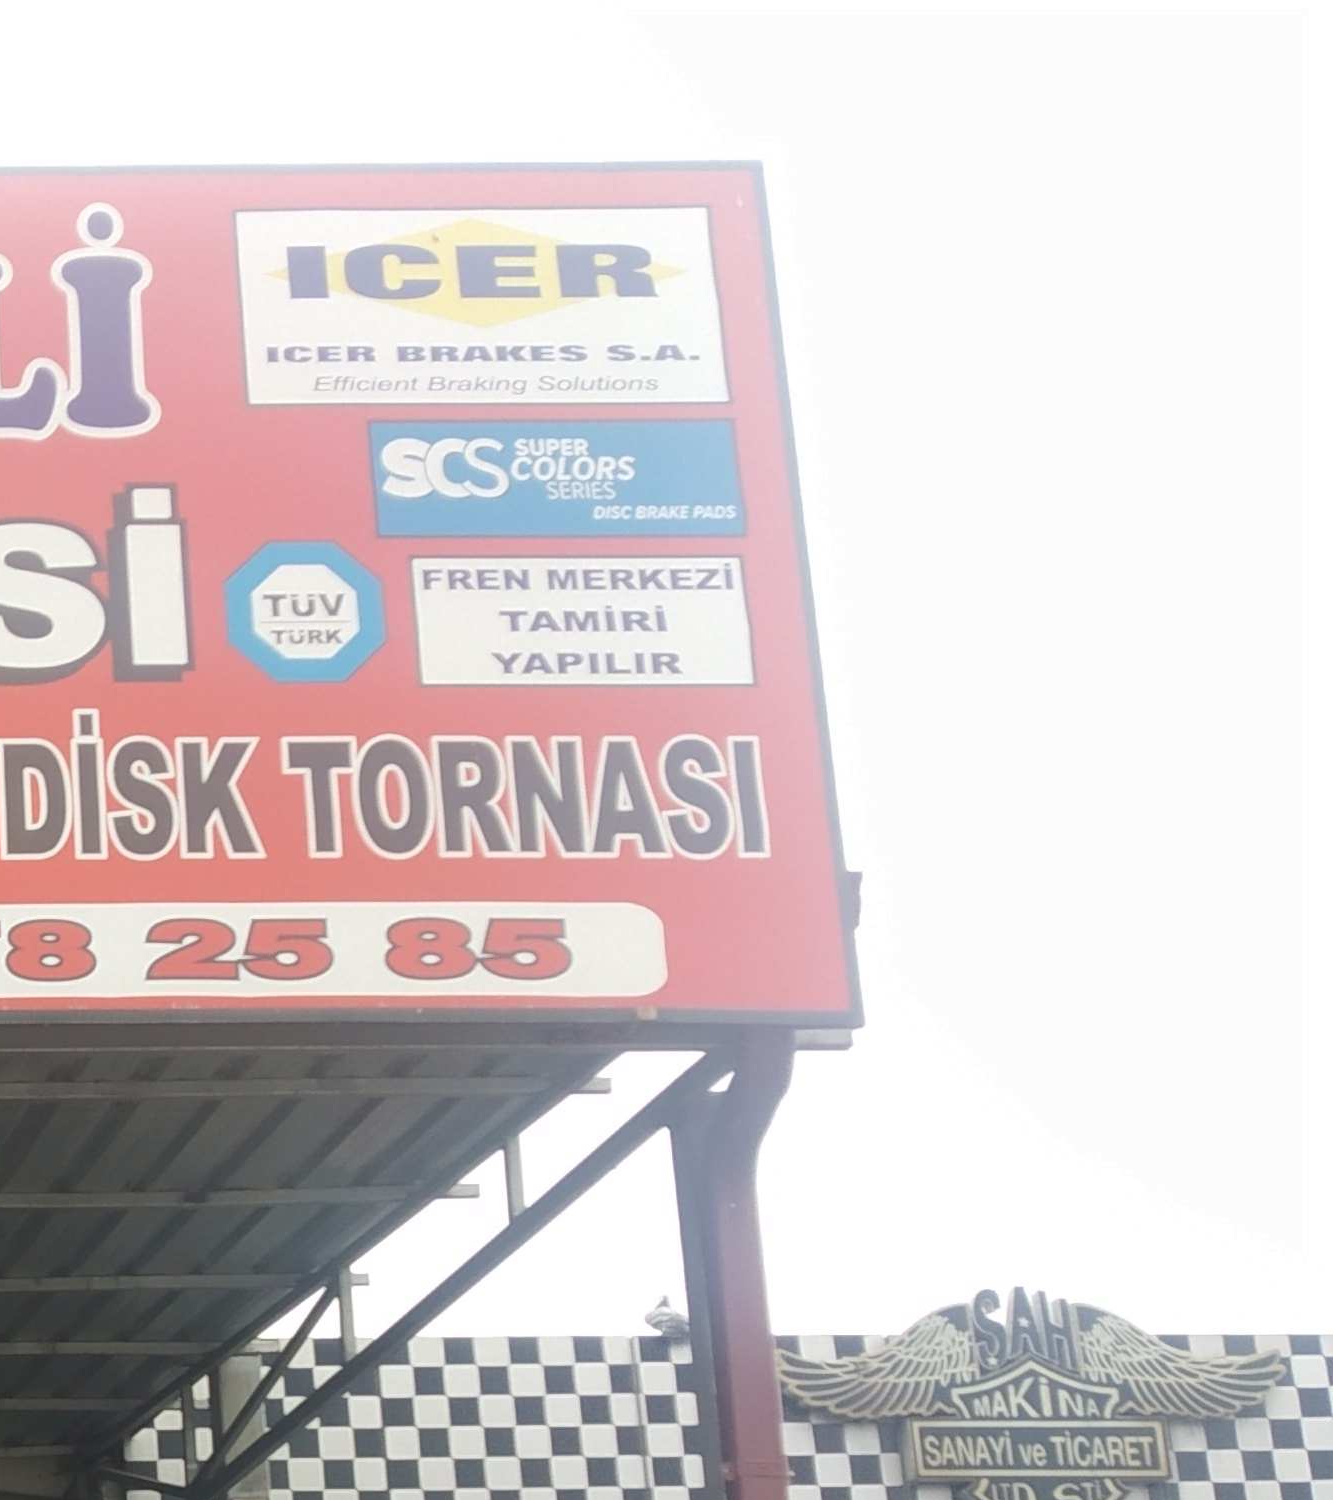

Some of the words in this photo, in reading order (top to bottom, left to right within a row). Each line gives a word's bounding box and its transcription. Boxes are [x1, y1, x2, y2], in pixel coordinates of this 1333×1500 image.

[286, 243, 660, 300] ICER
[266, 344, 377, 364] ICER
[397, 343, 588, 363] BRAKES
[607, 342, 701, 362] S.A.
[313, 374, 418, 394] Efficient
[428, 374, 528, 396] Braking
[538, 373, 660, 393] Solutions
[514, 437, 589, 457] SUPER
[380, 437, 510, 498] SCS
[511, 455, 636, 482] COLORS
[546, 479, 617, 501] SERIES
[593, 503, 631, 521] DISC
[635, 503, 689, 521] BRAKE
[693, 502, 737, 520] PADS
[422, 567, 531, 591] FREN
[547, 562, 735, 591] MERKEZİ
[263, 591, 344, 617] TÜV
[499, 604, 668, 632] TAMİRİ
[271, 629, 343, 646] TÜRK
[492, 651, 682, 675] YAPILIR
[279, 734, 771, 860] TORNASI
[144, 917, 334, 981] 25
[383, 917, 573, 981] 85
[923, 1430, 1014, 1468] SANAYİ
[1018, 1442, 1048, 1467] ve
[1049, 1430, 1154, 1467] TİCARET
